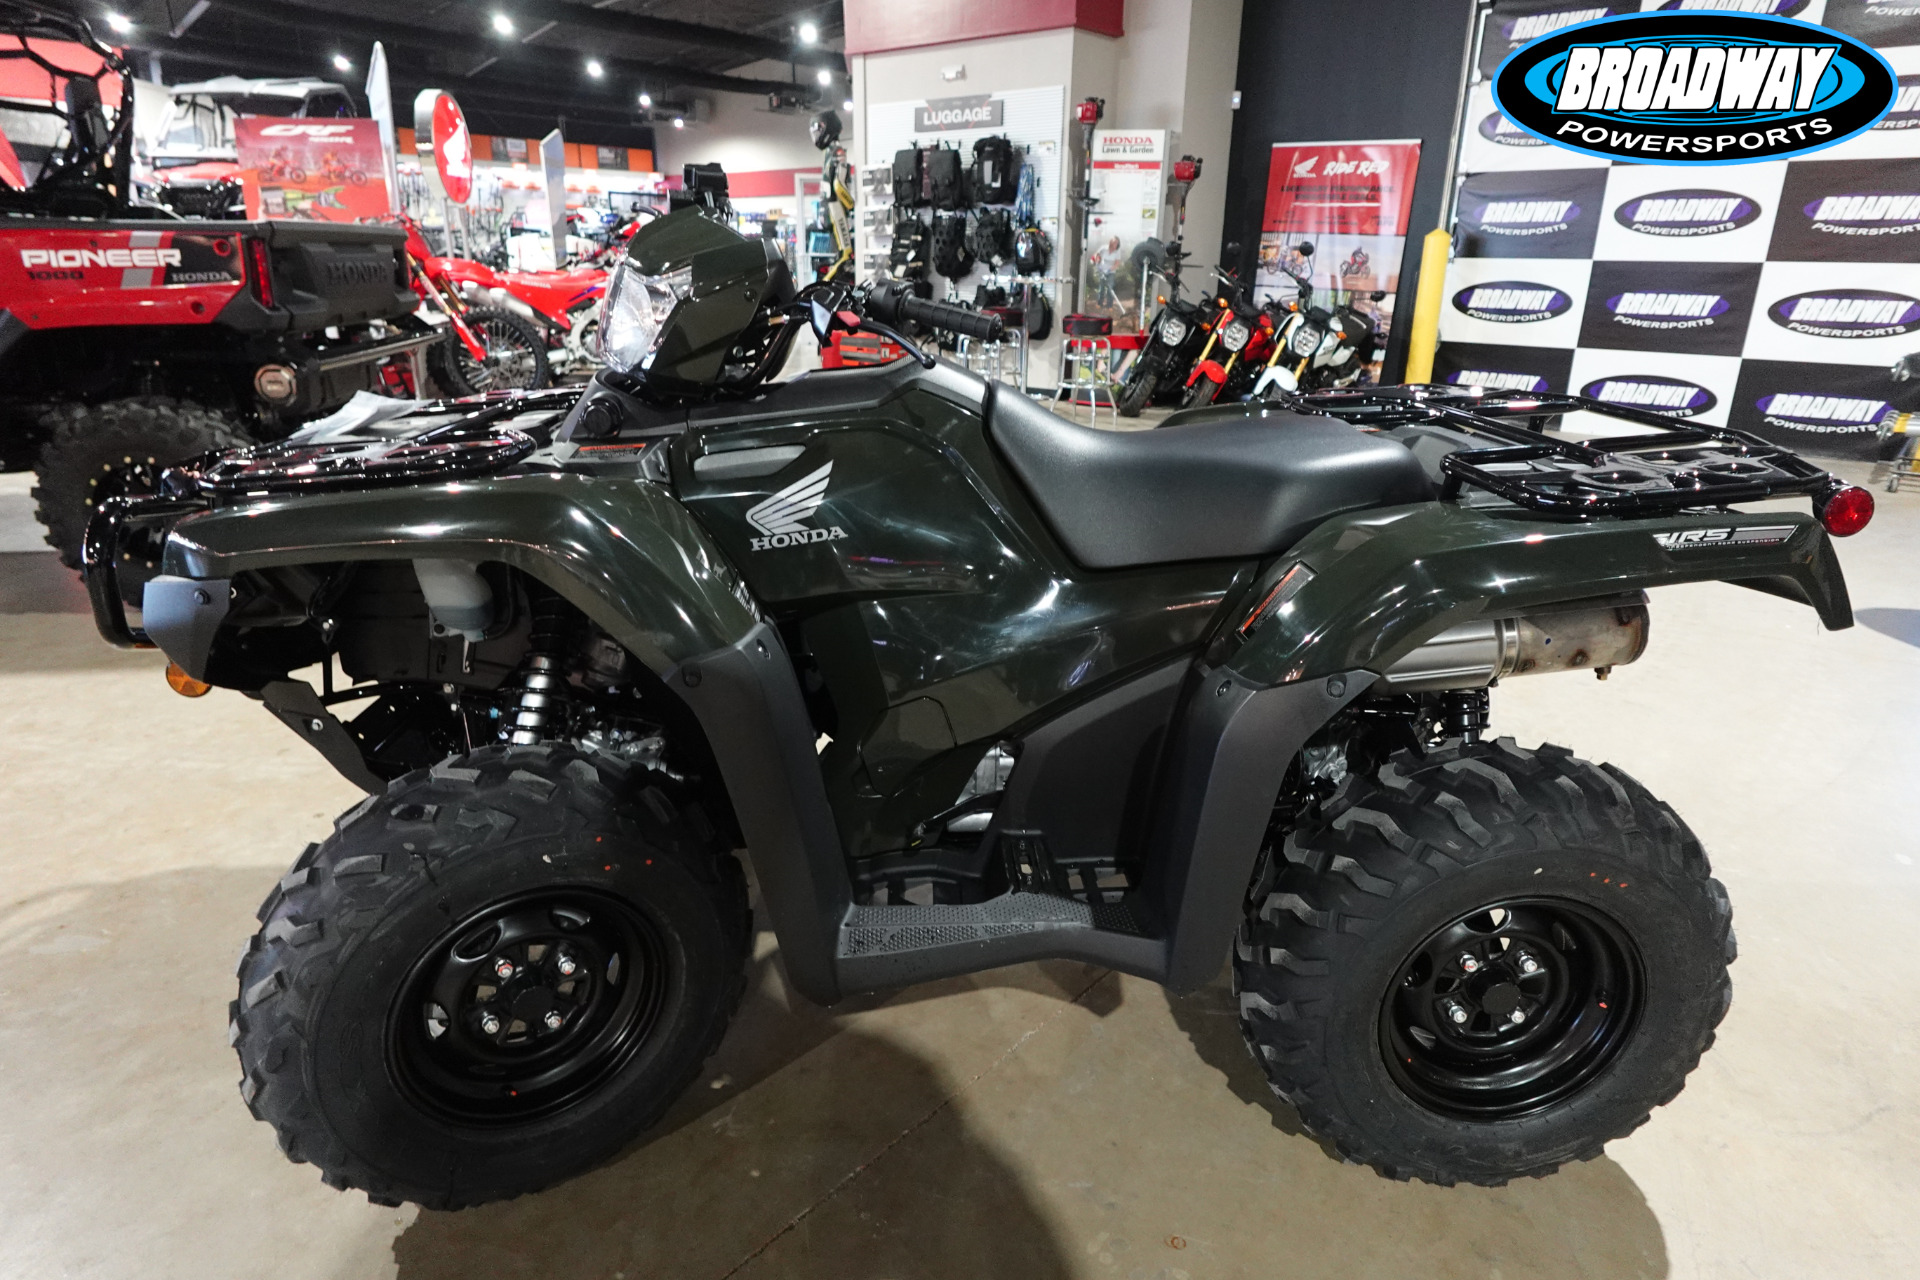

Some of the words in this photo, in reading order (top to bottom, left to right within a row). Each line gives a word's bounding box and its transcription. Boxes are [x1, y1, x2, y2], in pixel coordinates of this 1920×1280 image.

[923, 106, 992, 125] LUGGAGE
[260, 124, 355, 136] CRF
[1103, 136, 1153, 144] HONDA
[1323, 161, 1358, 176] RIDE
[1356, 161, 1390, 177] RED
[1481, 201, 1573, 223] BROADWAY
[1633, 198, 1743, 222] BROADWAY
[1813, 195, 1920, 221] BROADWA
[1480, 222, 1568, 236] POWERSPORTS
[1632, 222, 1736, 236] POWERSPORTS
[1811, 222, 1920, 236] POWERSPORT
[20, 249, 182, 268] PIONEER
[26, 270, 84, 281] 1000
[172, 271, 232, 282] HONDA
[326, 260, 388, 285] HONDA
[1467, 288, 1557, 311] BROADWAY
[1615, 292, 1721, 317] BROADWAY
[1466, 309, 1552, 322] POWERSPORTS
[1789, 297, 1915, 323] BROADWAY
[1613, 315, 1715, 329] POWERSPORTS
[1788, 322, 1906, 337] POWERSPORTS
[1456, 370, 1541, 391] BROADWAY
[1598, 381, 1700, 407] BROADWAY
[1765, 393, 1886, 422] BROADWAY
[1763, 416, 1878, 433] POWERSPORTS
[749, 526, 848, 551] HONDA
[1669, 528, 1731, 543] IRS
